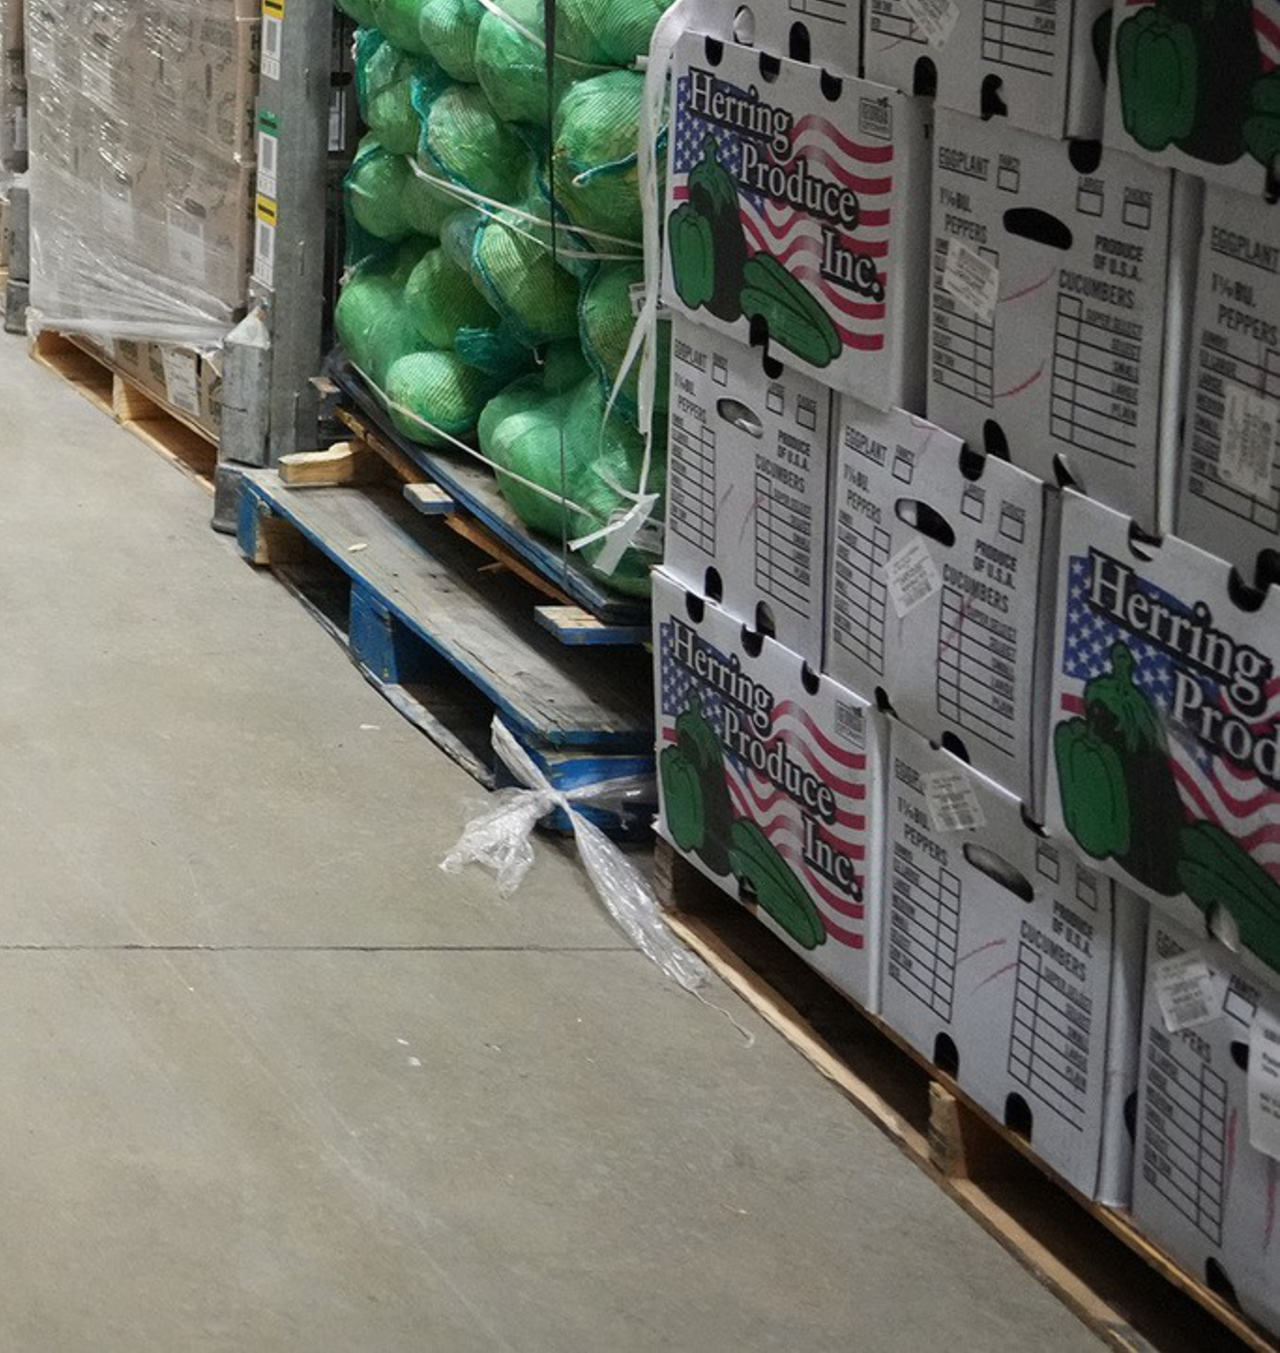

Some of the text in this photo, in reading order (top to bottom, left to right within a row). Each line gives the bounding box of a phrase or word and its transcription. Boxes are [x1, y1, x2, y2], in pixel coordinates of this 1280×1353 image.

[689, 69, 791, 153] Herring
[739, 141, 856, 222] Produce
[821, 229, 881, 294] Inc.
[1059, 269, 1135, 309] CUCUMBERS
[1095, 235, 1143, 263] PRODUCE
[1218, 304, 1278, 346] PEPPERS
[1088, 551, 1267, 707] Herring
[670, 617, 772, 730] Herring
[722, 703, 834, 816] Produce
[802, 816, 862, 896] Inc.
